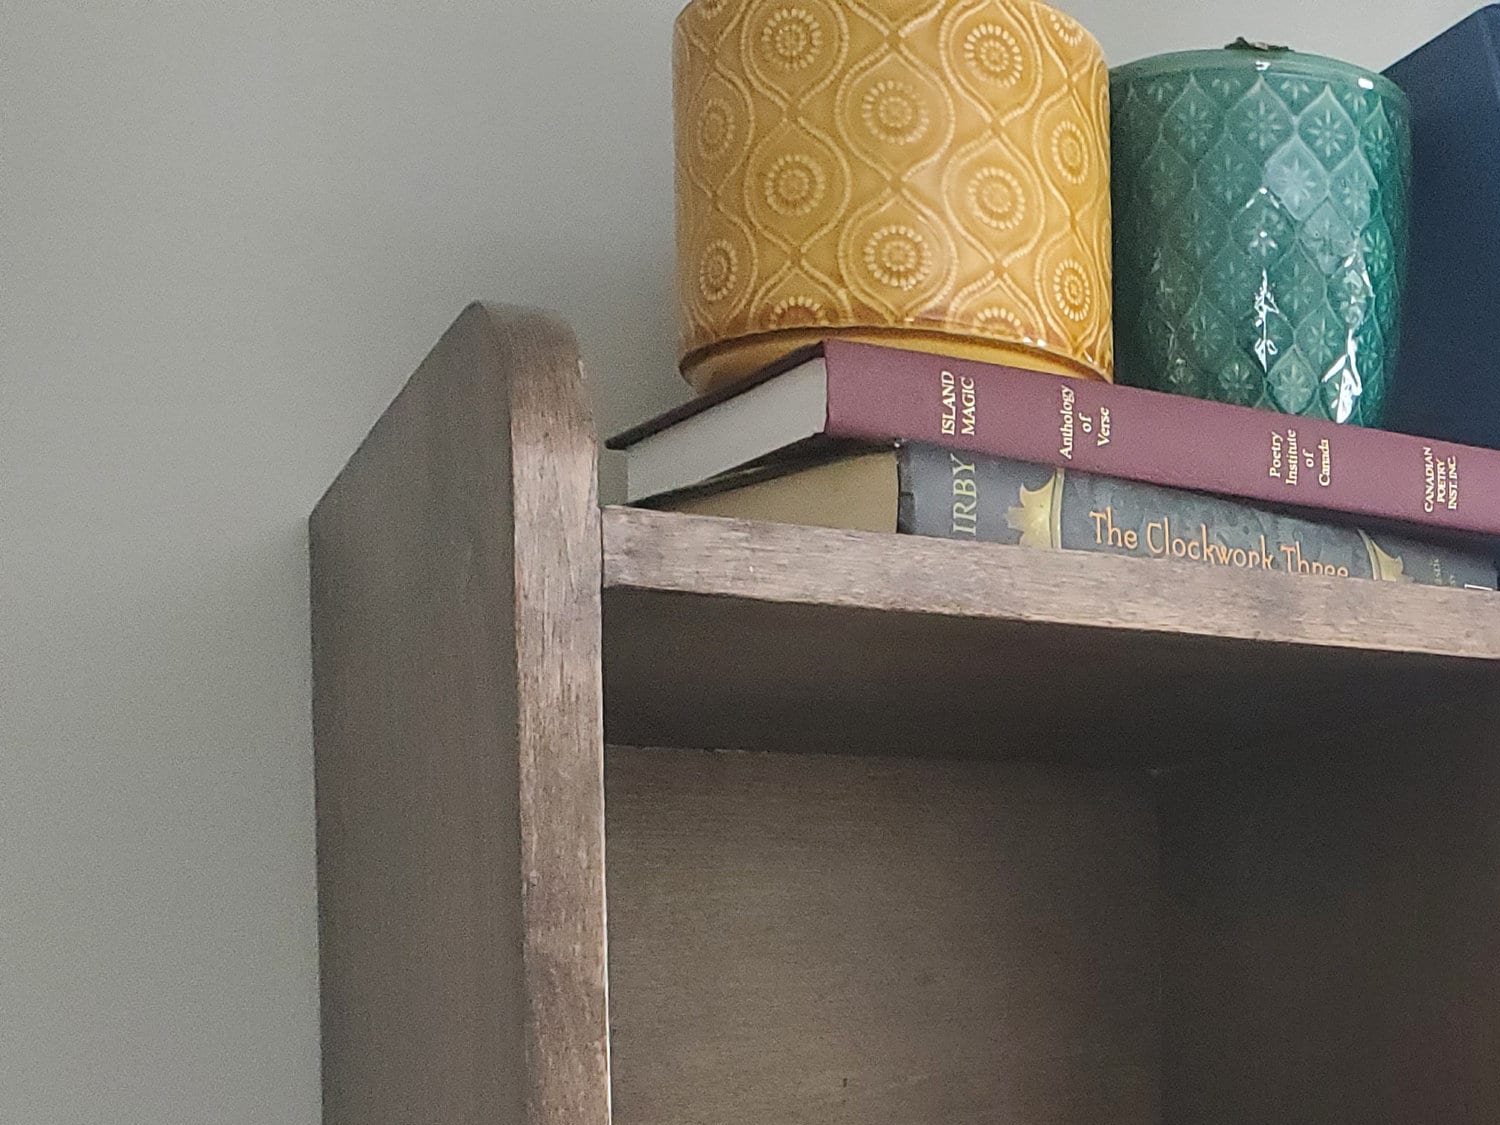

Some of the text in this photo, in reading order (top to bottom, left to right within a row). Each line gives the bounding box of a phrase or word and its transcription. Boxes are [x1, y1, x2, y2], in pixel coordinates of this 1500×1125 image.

[941, 371, 956, 435] ISLAND
[961, 377, 976, 436] MAGIC
[1059, 385, 1075, 459] Anthology
[1078, 413, 1092, 433] of
[1097, 407, 1111, 446] Verse
[1269, 431, 1284, 478] Poetry
[1285, 429, 1298, 486] Institute
[1302, 448, 1315, 468] of
[1318, 438, 1330, 487] Canada
[1423, 446, 1435, 513] CANADIAN
[1436, 457, 1447, 503] POETRY
[1089, 506, 1138, 550] The
[1146, 516, 1275, 570] Clockwork
